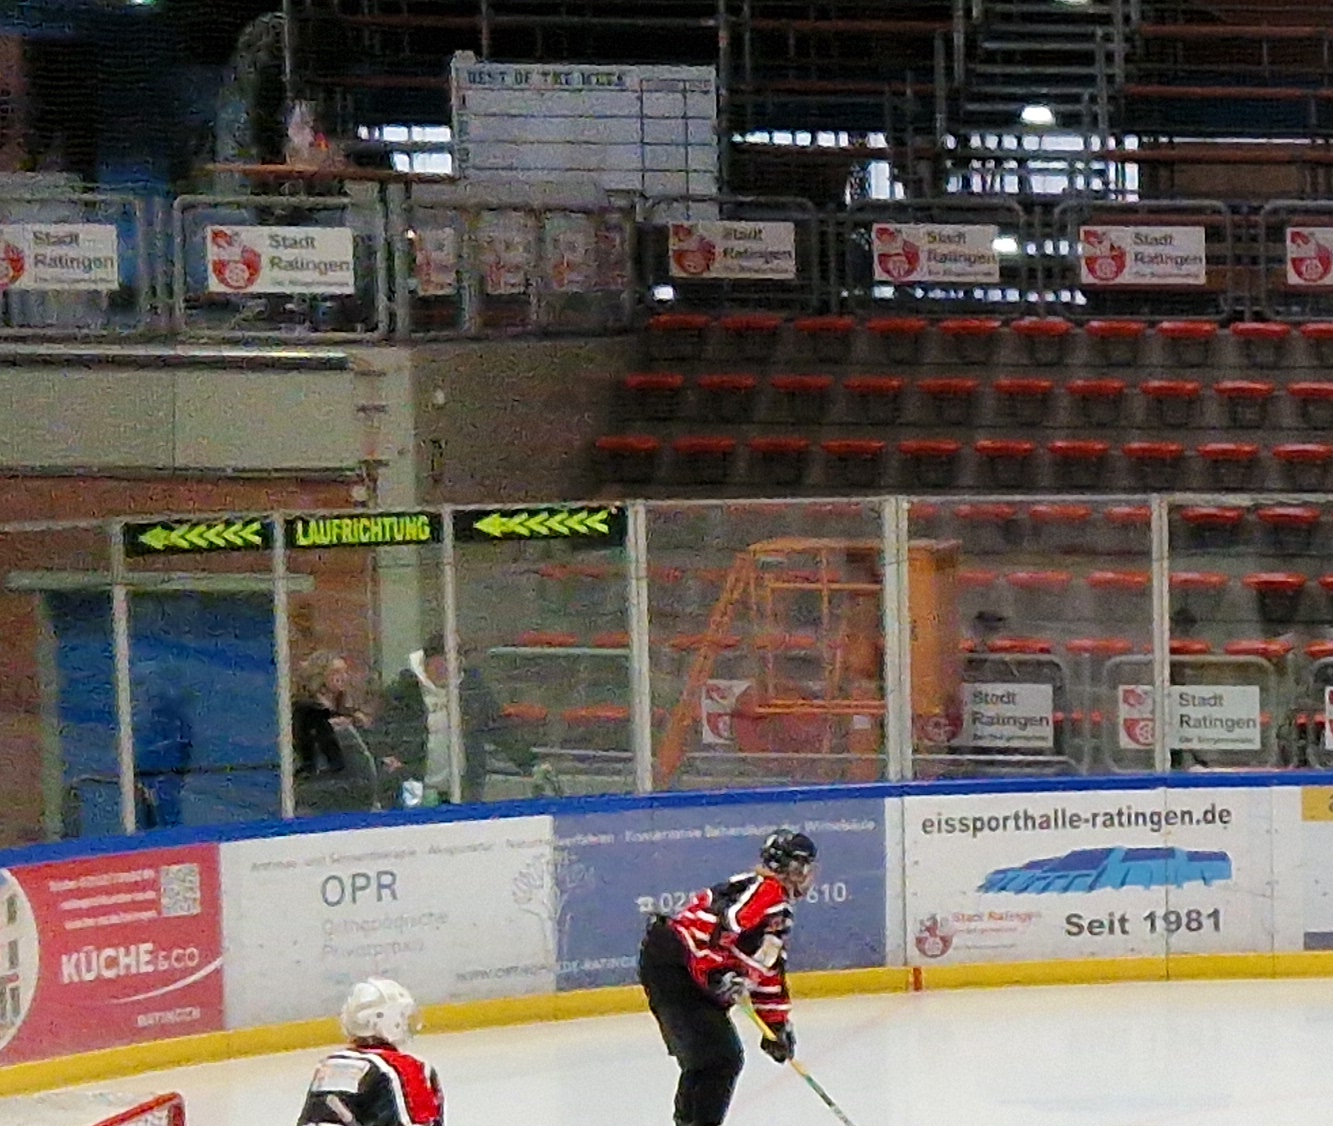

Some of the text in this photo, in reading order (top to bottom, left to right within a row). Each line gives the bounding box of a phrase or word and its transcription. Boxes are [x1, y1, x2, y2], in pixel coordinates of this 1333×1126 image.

[296, 512, 431, 547] LAUFRICHTUNG
[1179, 692, 1224, 708] Stadt
[972, 710, 1050, 732] Ratingen
[1179, 713, 1257, 734] Ratingen
[922, 803, 1232, 838] eissporthalle-ratingen.de
[321, 869, 398, 907] OPR
[1065, 909, 1222, 937] Seit 1981
[61, 943, 154, 984] KÜCHE
